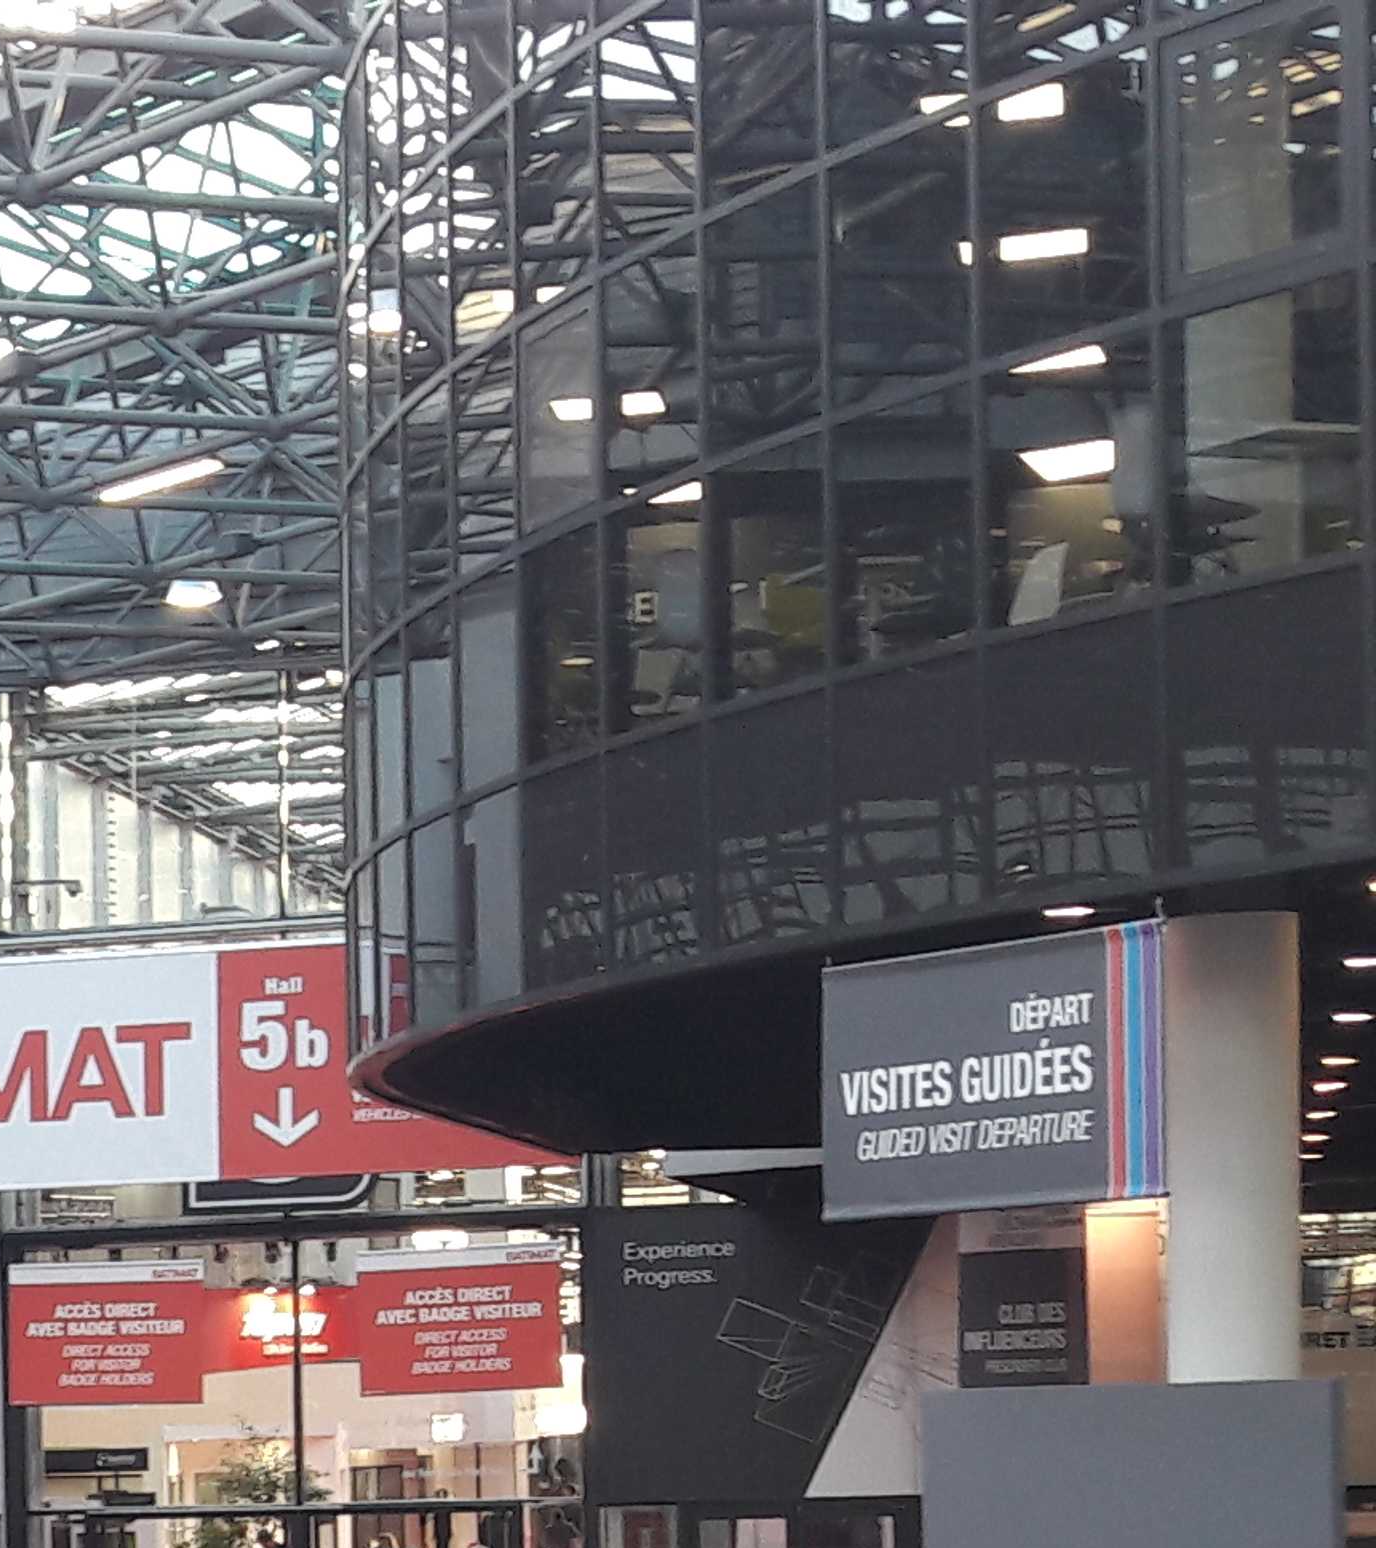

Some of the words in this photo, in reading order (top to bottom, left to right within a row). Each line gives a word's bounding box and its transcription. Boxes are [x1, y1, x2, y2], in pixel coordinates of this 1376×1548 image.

[265, 977, 303, 995] Hall
[1010, 993, 1094, 1032] DÉPART
[240, 1000, 328, 1071] 5b
[840, 1060, 952, 1115] VISITES
[961, 1038, 1094, 1103] GUIDÉES
[857, 1127, 925, 1162] GUIDED
[929, 1121, 976, 1153] VISIT
[978, 1110, 1095, 1149] DEPARTURE
[623, 1240, 736, 1264] Experience
[623, 1267, 718, 1289] Progress.
[404, 1286, 454, 1305] ACCÈS
[456, 1285, 512, 1301] DIRECT
[53, 1301, 102, 1318] ACCÈS
[104, 1303, 157, 1317] DIRECT
[375, 1309, 417, 1325] AVEC
[418, 1306, 470, 1323] BADGE
[472, 1303, 543, 1320] VISITEUR
[26, 1322, 65, 1337] AVEC
[67, 1321, 117, 1336] BADGE
[119, 1320, 185, 1335] VISITEUR
